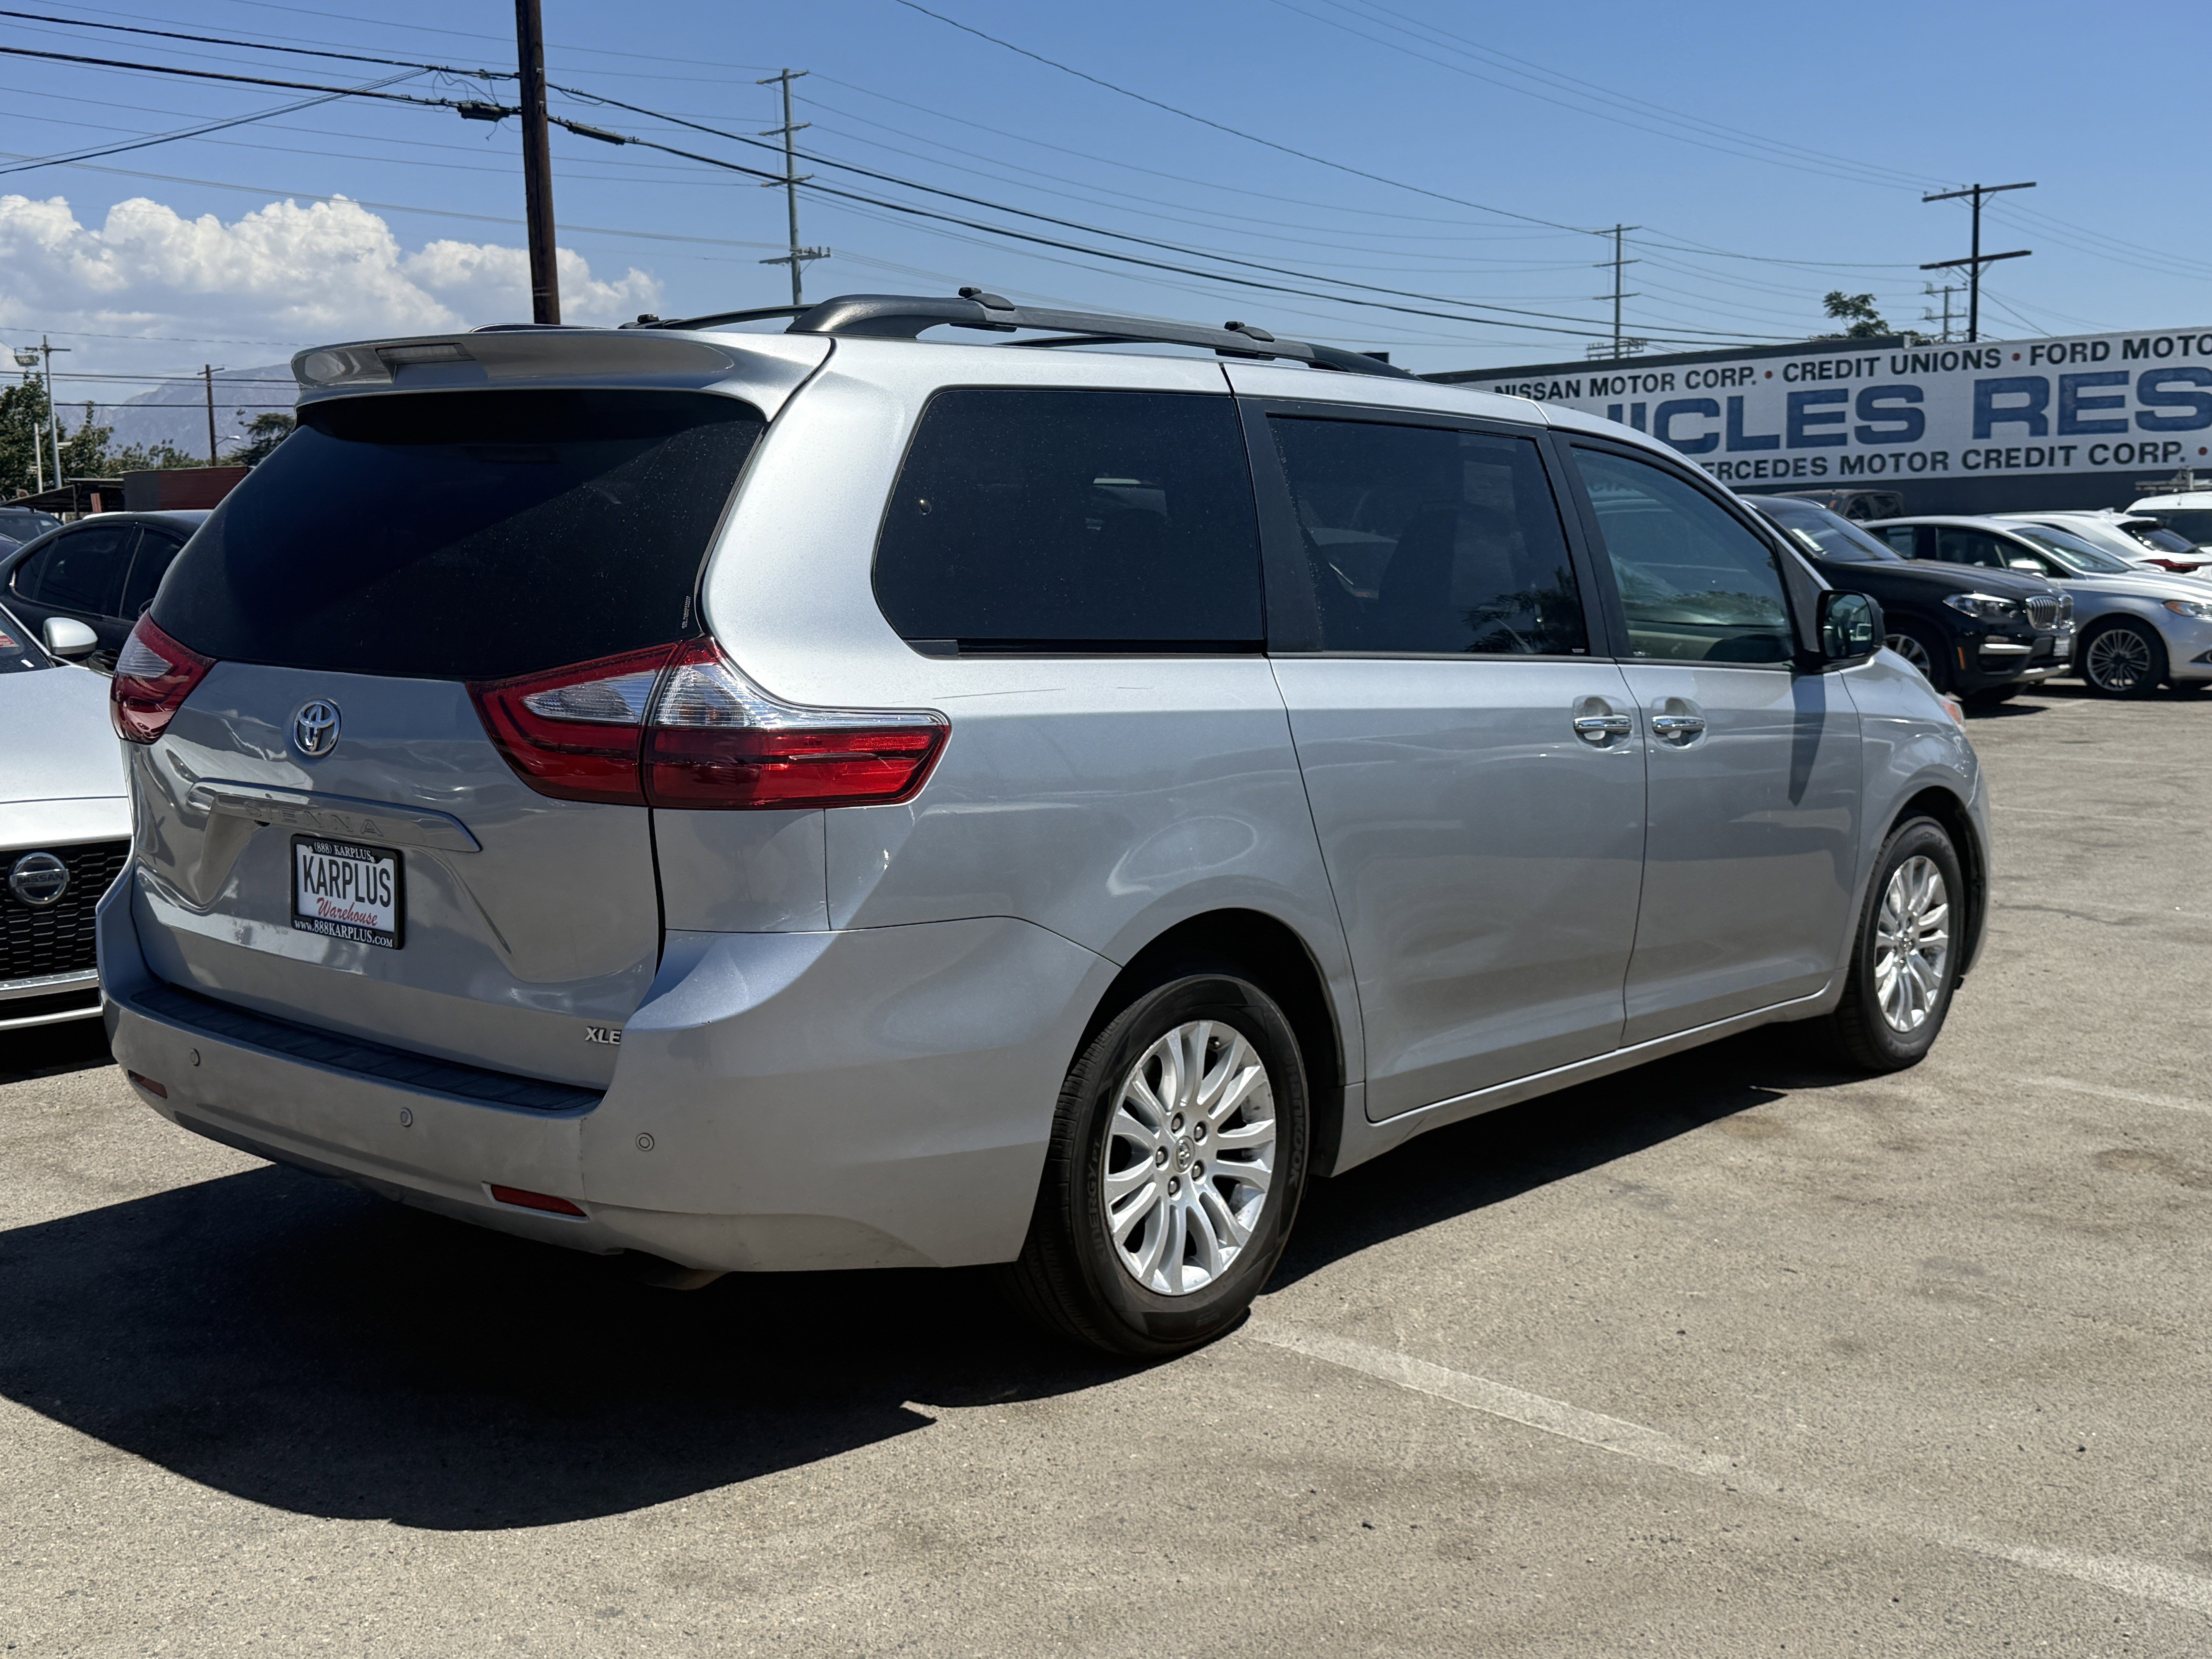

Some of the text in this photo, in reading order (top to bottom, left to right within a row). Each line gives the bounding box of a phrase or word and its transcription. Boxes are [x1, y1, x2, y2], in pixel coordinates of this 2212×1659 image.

[1590, 372, 1674, 397] MOTOR
[1685, 367, 1757, 388] CORP.
[1783, 357, 1881, 383] CREDIT
[1891, 348, 2001, 375] UNIONS
[2030, 341, 2110, 366] FORD
[1973, 366, 2212, 440] RES
[1840, 451, 1949, 475] MOTOR
[1961, 445, 2077, 470] CREDIT
[2088, 441, 2186, 465] CORP.
[244, 801, 384, 837] SIENNA
[314, 842, 371, 860] (888) KARPLUS
[17, 873, 64, 884] NISSAN
[303, 854, 392, 908] KARPLUS
[316, 896, 378, 926] Warehouse
[585, 1026, 622, 1044] XLE
